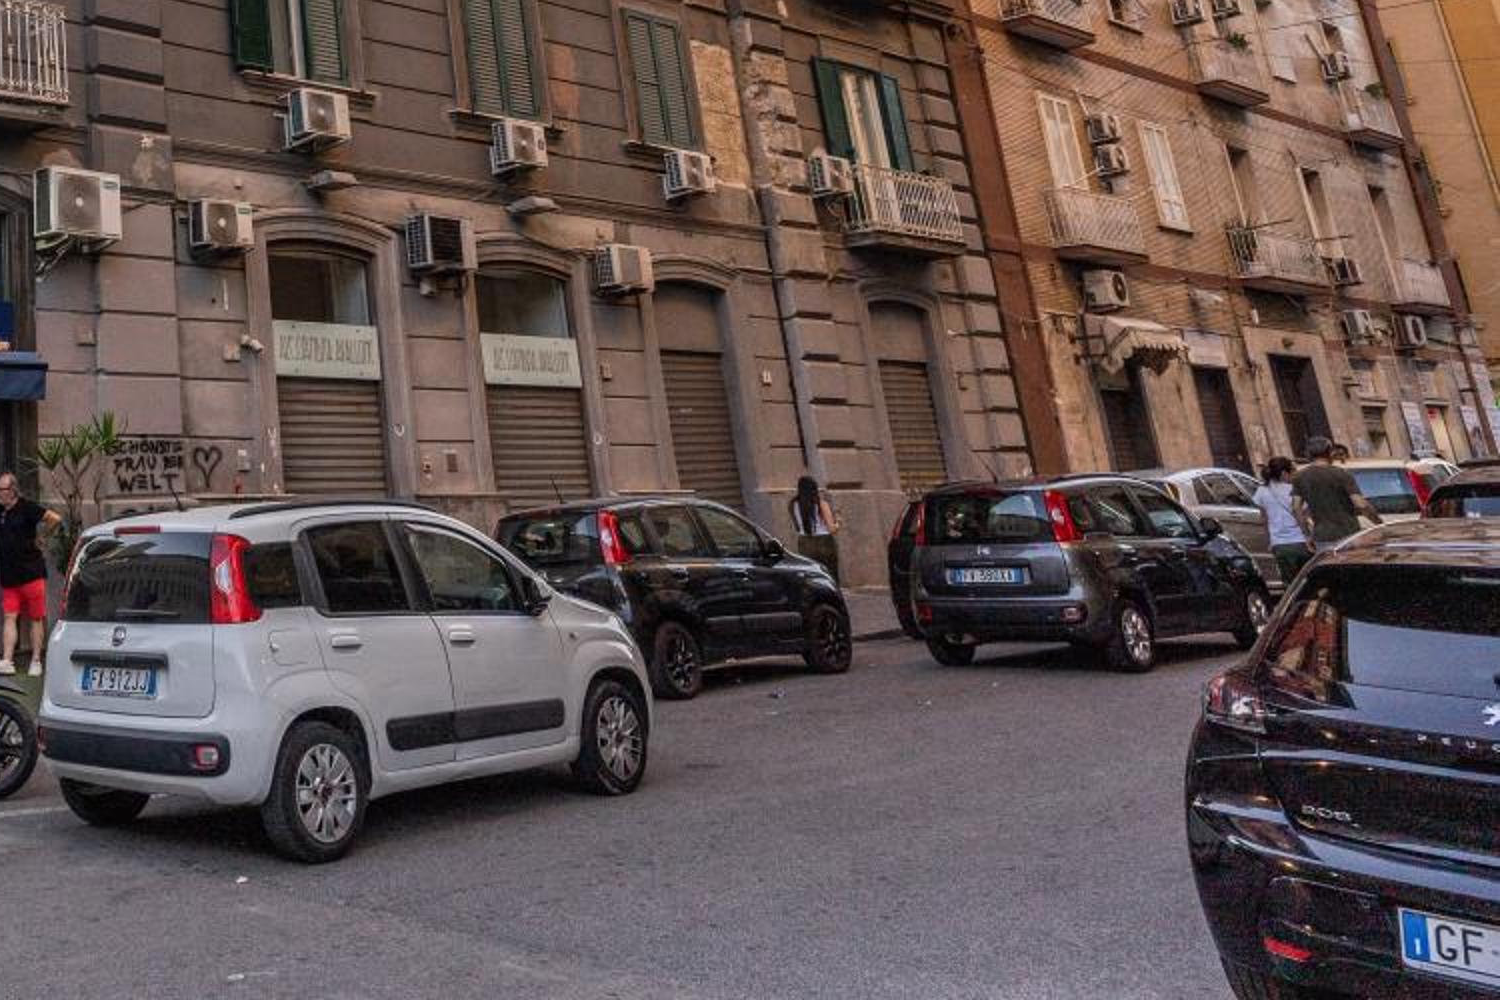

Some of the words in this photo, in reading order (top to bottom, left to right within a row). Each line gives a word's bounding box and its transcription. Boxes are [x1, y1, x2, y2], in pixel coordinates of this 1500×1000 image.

[113, 455, 157, 474] FRAU
[117, 473, 179, 492] WELT
[1302, 805, 1352, 820] 208
[1435, 925, 1484, 966] GF
